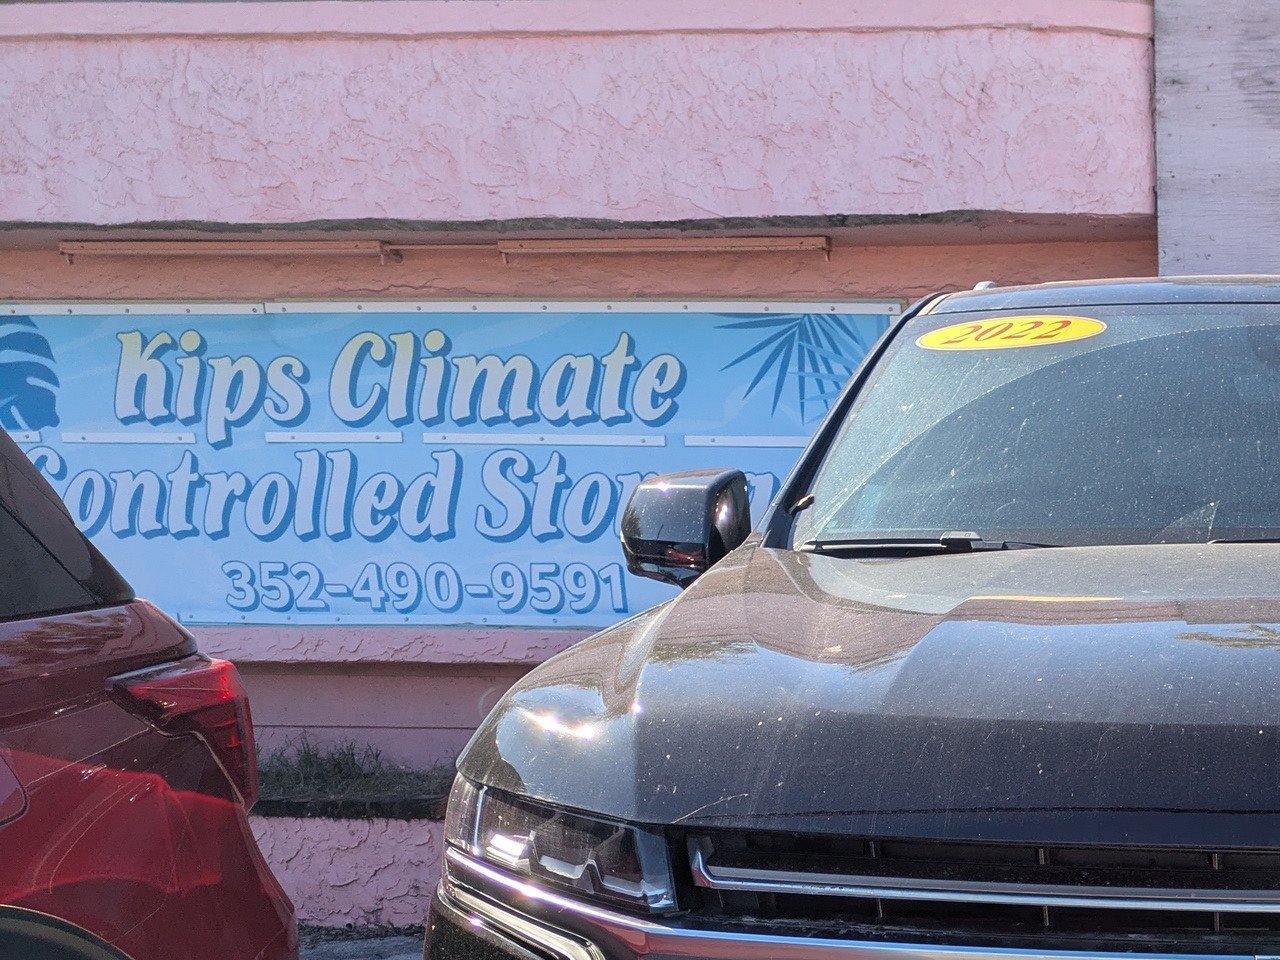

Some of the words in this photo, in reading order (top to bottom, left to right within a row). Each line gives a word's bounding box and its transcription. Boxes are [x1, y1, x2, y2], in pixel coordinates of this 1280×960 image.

[940, 320, 1072, 345] 2022
[114, 328, 311, 450] Kips
[328, 328, 688, 428] Climate
[221, 559, 628, 614] 352-490-9591
